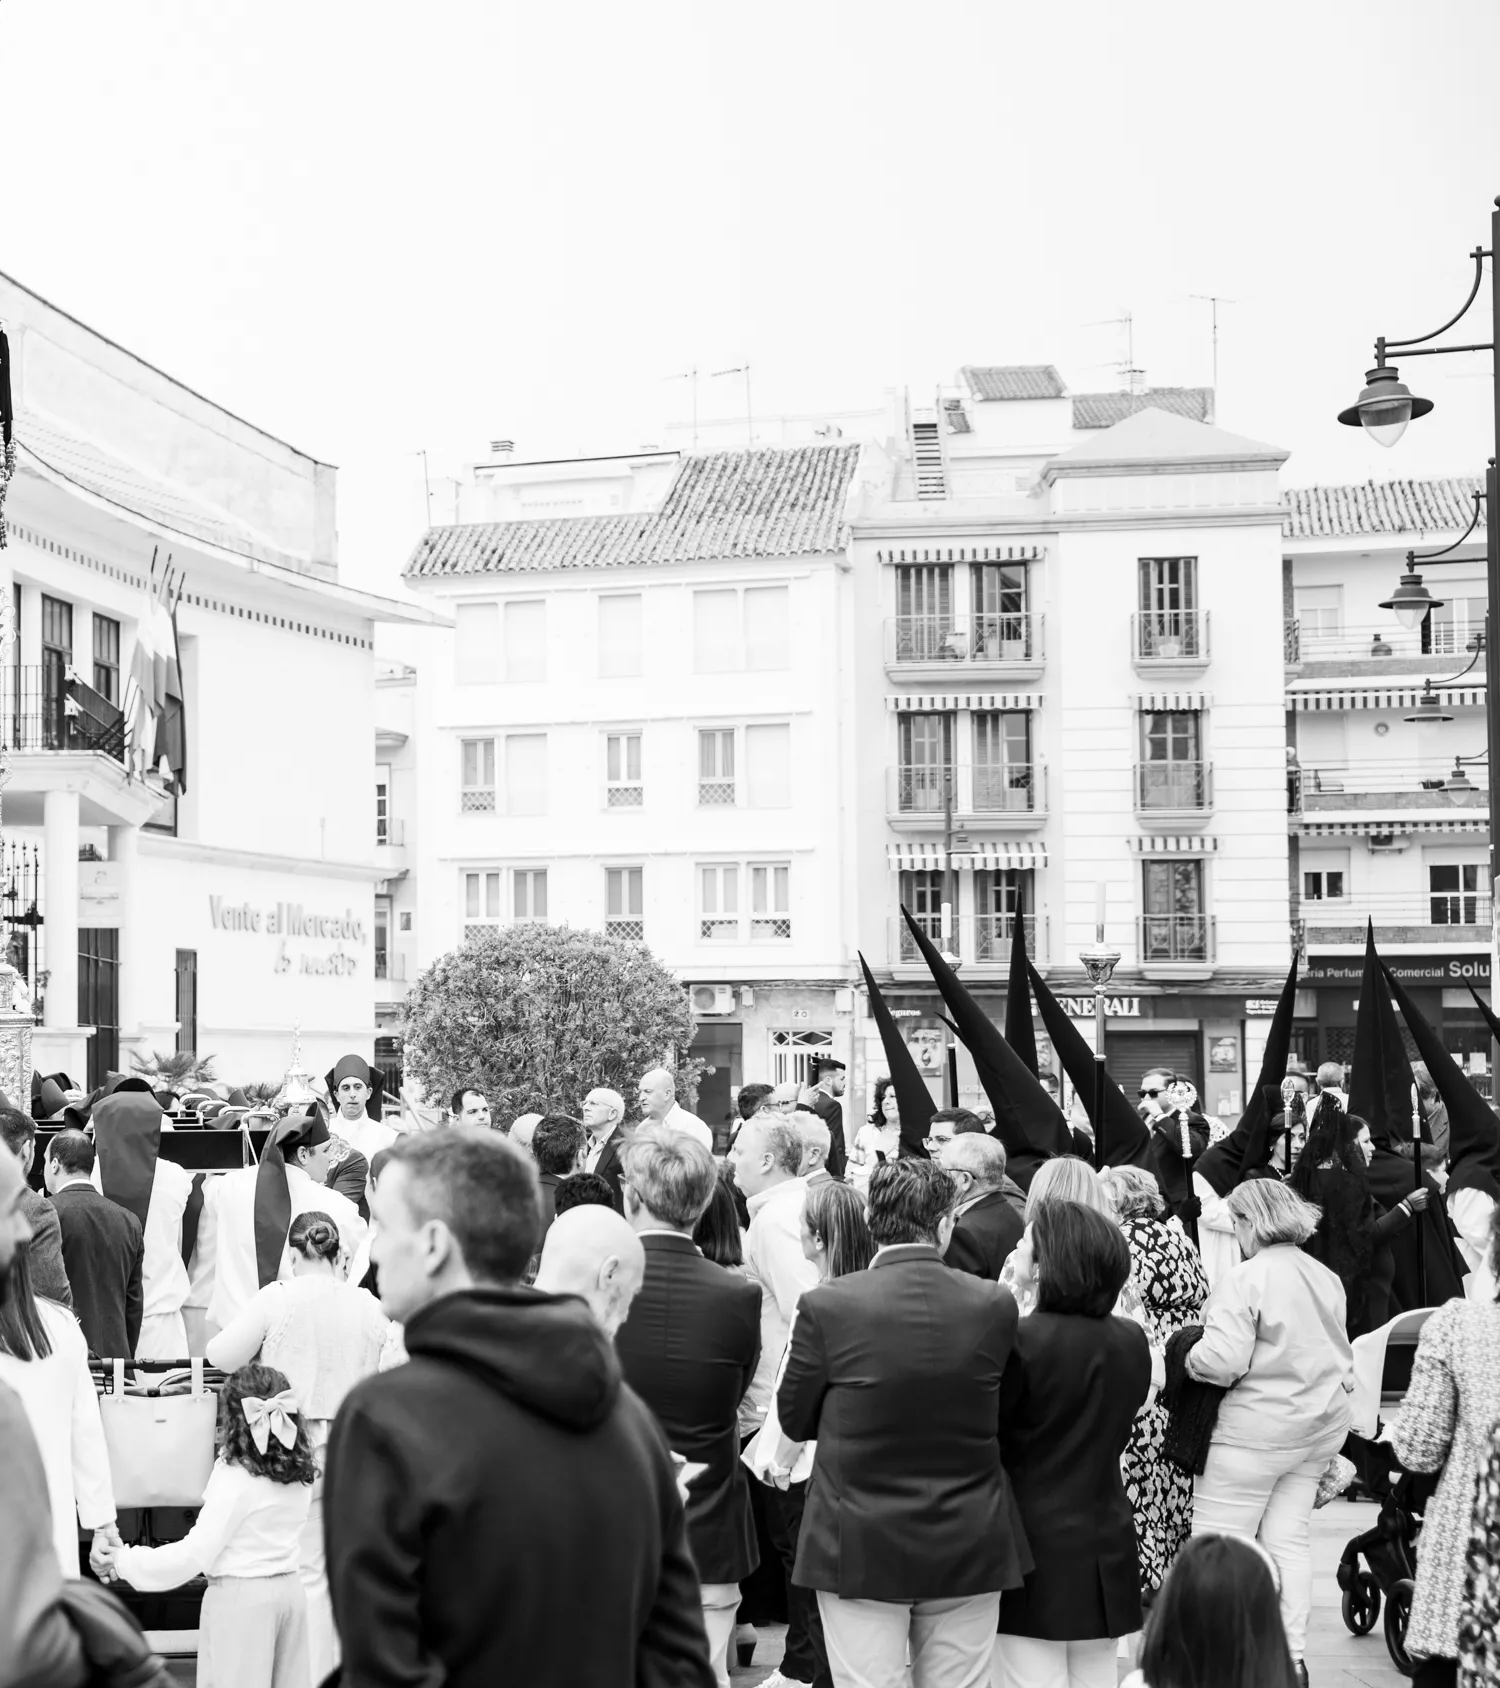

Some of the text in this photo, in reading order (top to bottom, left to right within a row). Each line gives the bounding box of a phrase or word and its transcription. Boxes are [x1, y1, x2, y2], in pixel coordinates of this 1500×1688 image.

[209, 894, 367, 946] Vente al Mercado,
[1326, 967, 1364, 978] Perfum
